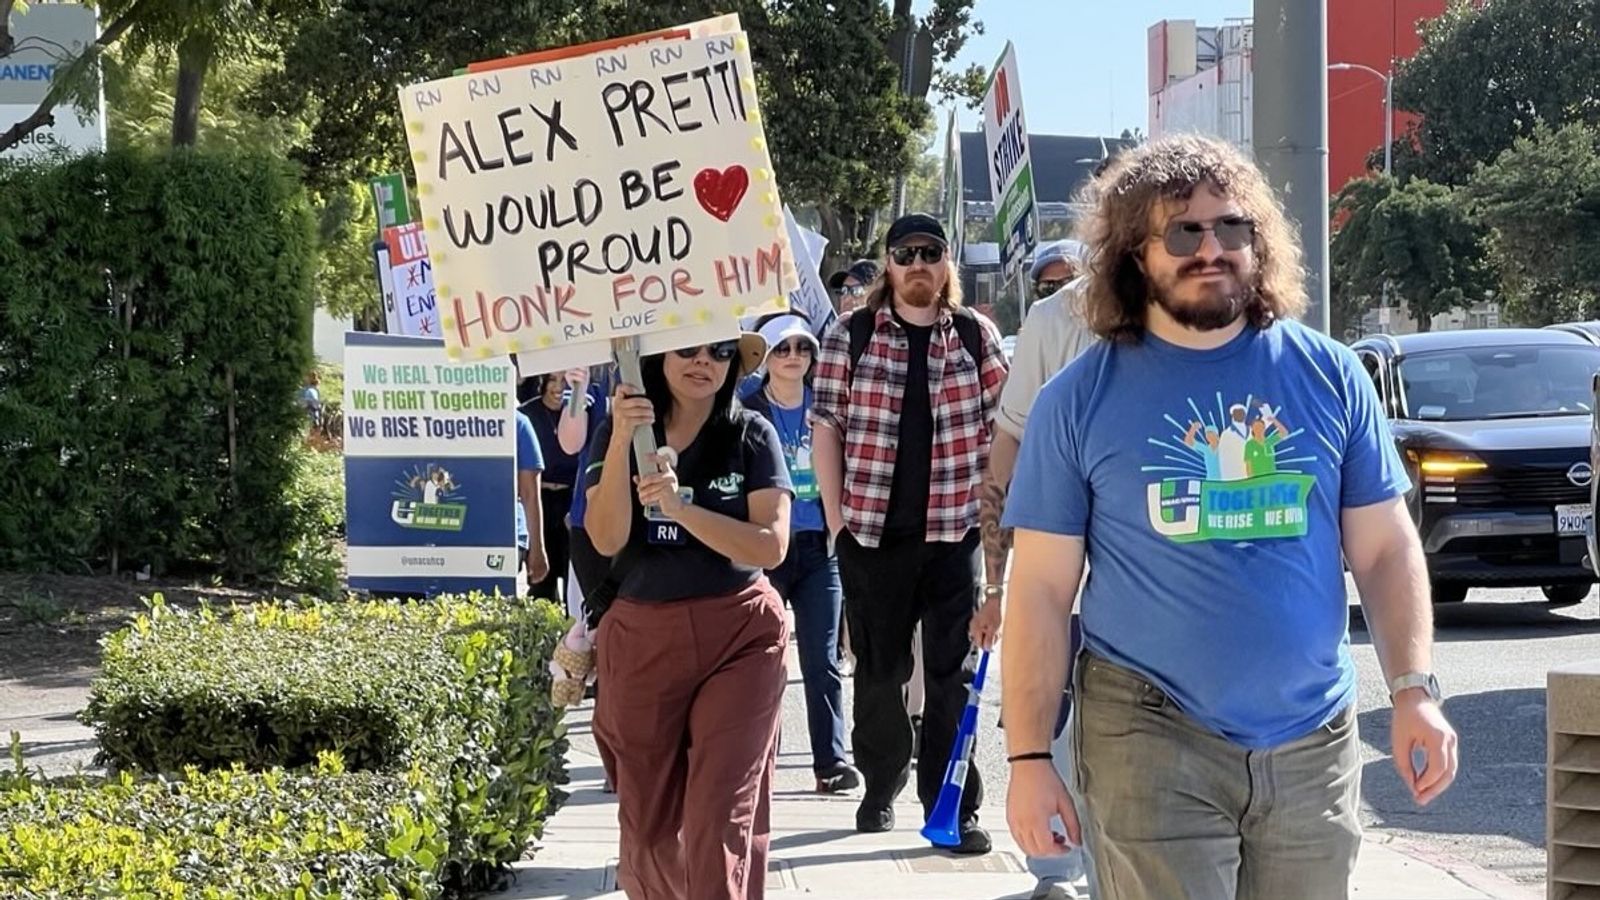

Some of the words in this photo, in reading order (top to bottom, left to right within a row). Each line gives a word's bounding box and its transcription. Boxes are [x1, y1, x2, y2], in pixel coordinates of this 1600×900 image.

[415, 88, 442, 111] RN
[468, 75, 501, 101] RN
[530, 66, 562, 89] RN
[595, 54, 627, 77] RN
[650, 44, 682, 68] RN
[705, 37, 735, 59] RN
[439, 99, 578, 180] ALEX
[602, 60, 747, 147] PRETTI
[993, 107, 1025, 195] STRIKE
[443, 178, 602, 249] WOULD
[619, 160, 684, 210] BE
[538, 216, 692, 294] PROUD
[453, 284, 592, 348] HONK
[612, 268, 704, 311] FOR
[714, 242, 782, 297] HIM
[563, 322, 594, 341] RN
[610, 308, 657, 330] LOVE
[352, 390, 377, 410] We
[382, 390, 425, 410] FIGHT
[430, 390, 508, 412] Together
[363, 364, 387, 384] We
[392, 365, 430, 384] HEAL
[434, 364, 509, 386] Together
[348, 416, 375, 437] We
[381, 416, 418, 437] RISE
[423, 416, 505, 439] Together
[657, 525, 678, 541] RN
[1208, 514, 1223, 529] WE
[1225, 513, 1253, 529] RISE
[1265, 510, 1282, 526] WE
